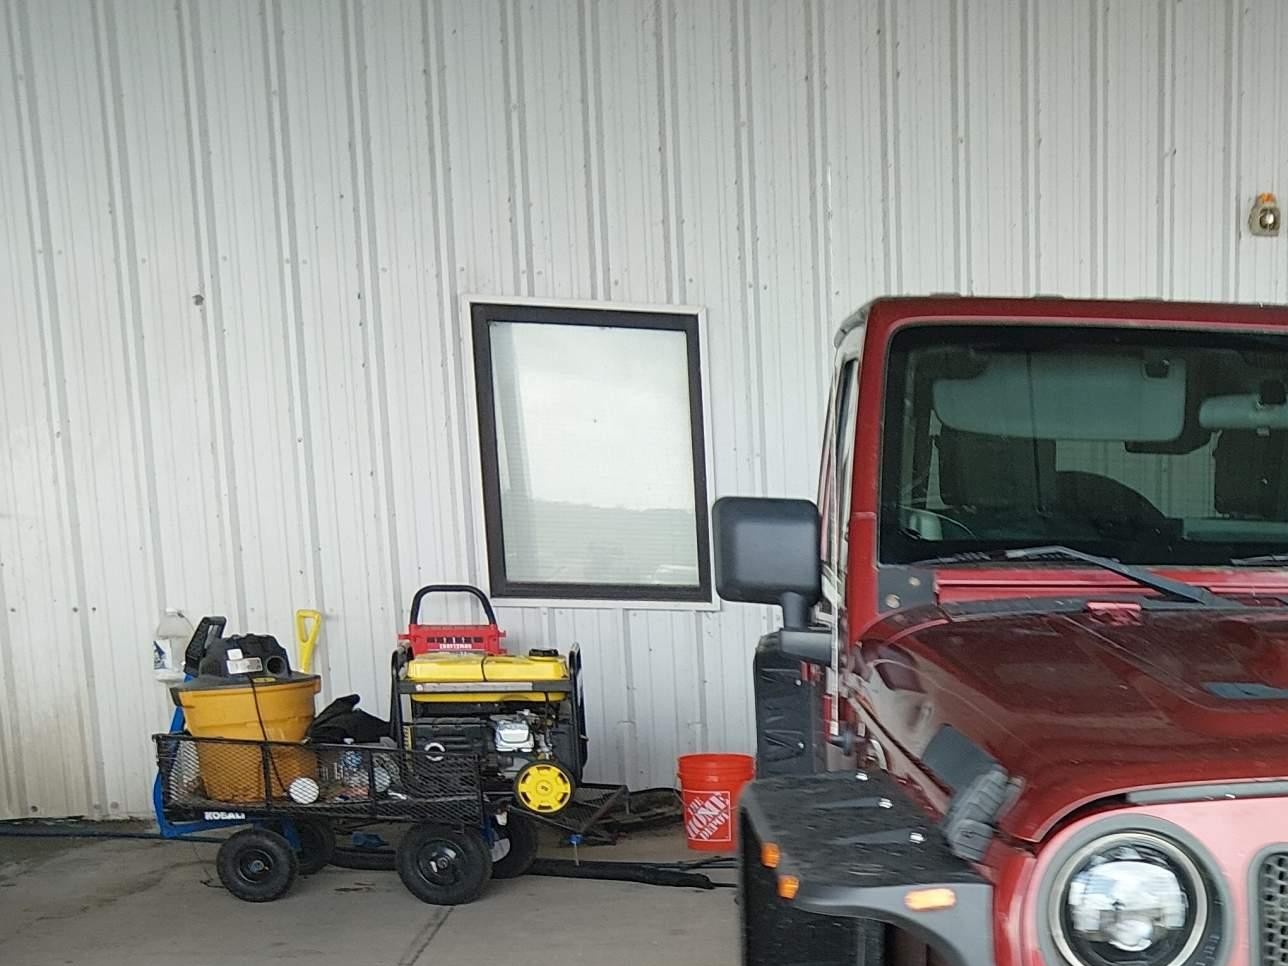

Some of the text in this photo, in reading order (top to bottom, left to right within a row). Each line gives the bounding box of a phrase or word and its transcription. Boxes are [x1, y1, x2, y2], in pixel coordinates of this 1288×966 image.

[687, 793, 730, 839] HOME
[688, 797, 705, 815] THE
[699, 811, 730, 840] DEPOT
